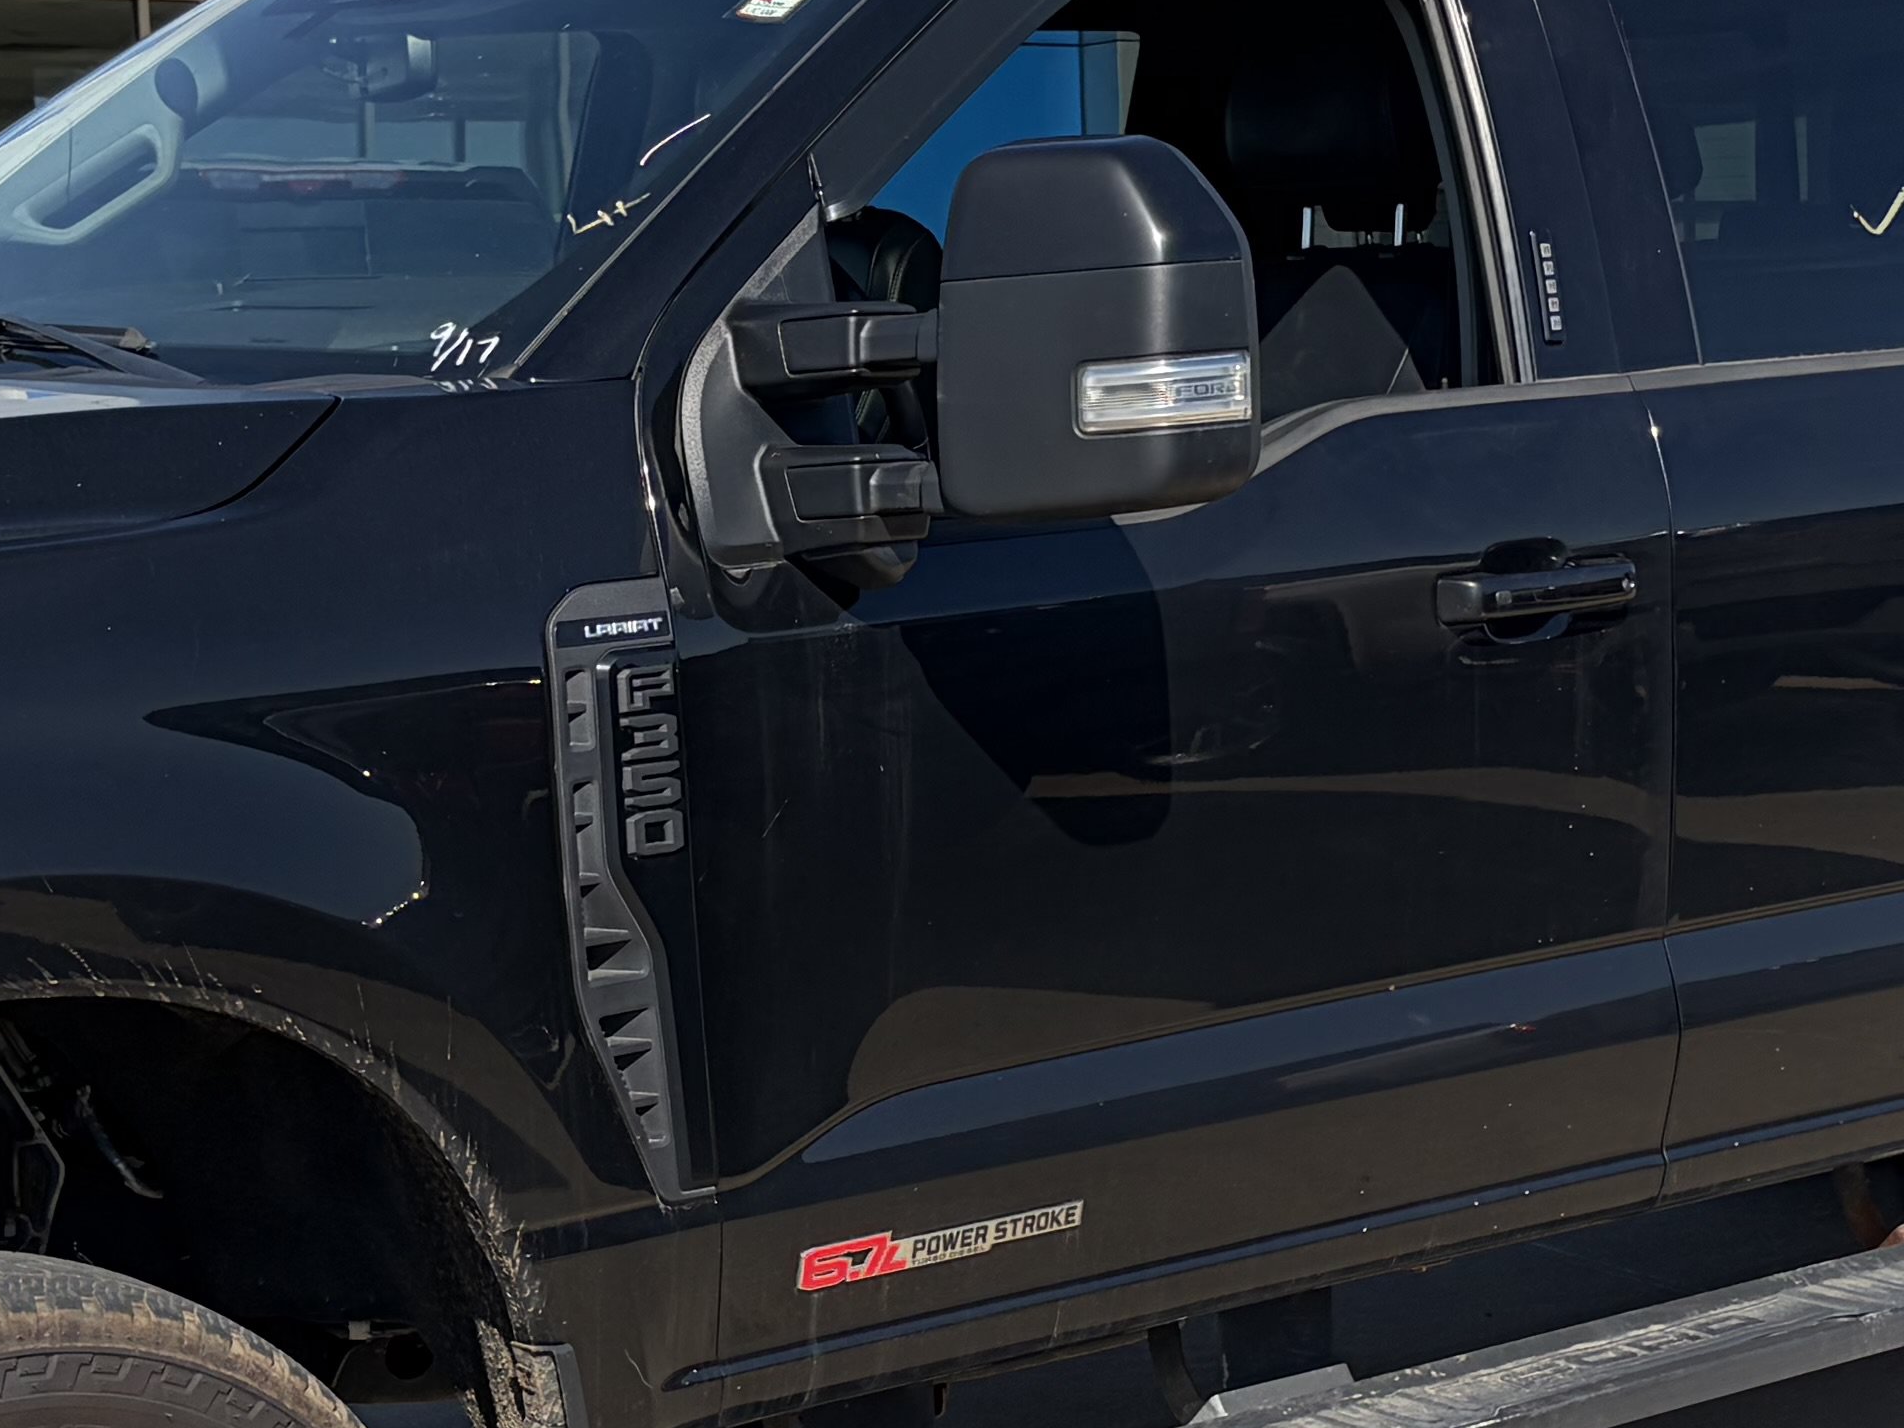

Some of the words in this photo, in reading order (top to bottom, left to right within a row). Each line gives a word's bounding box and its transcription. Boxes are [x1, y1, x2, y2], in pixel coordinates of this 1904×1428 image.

[430, 322, 500, 372] 9/17
[584, 617, 663, 638] LARIAT
[911, 1224, 989, 1259] POWER
[993, 1204, 1078, 1240] STROKE
